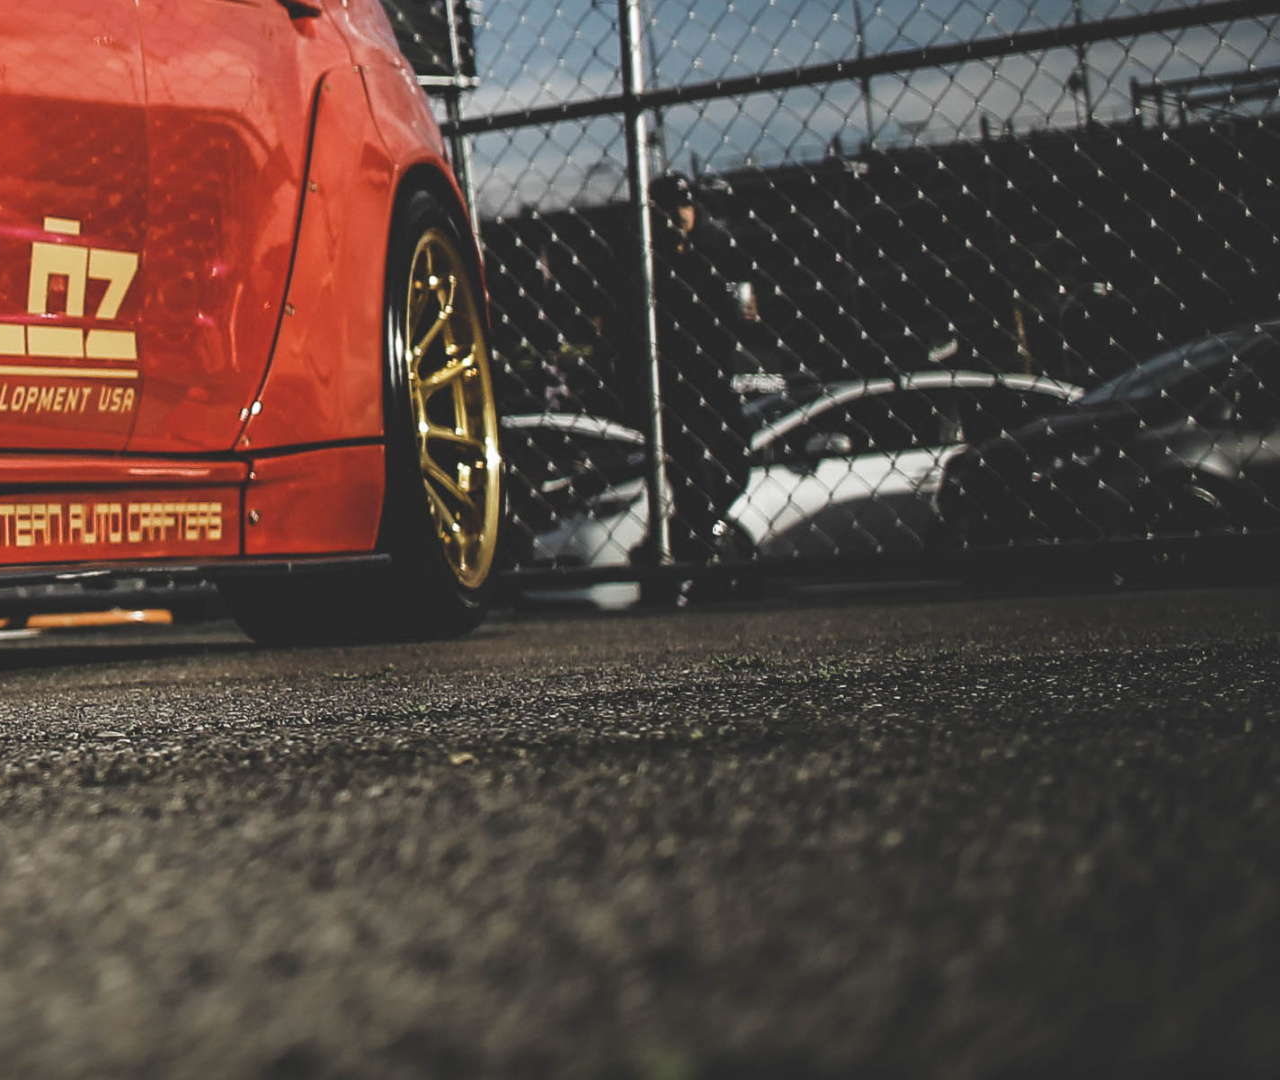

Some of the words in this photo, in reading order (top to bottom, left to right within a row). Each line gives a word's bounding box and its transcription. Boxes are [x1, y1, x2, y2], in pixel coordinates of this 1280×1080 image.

[98, 387, 135, 413] USA
[70, 502, 122, 544] AUTO
[128, 502, 222, 542] CRAFTERS
